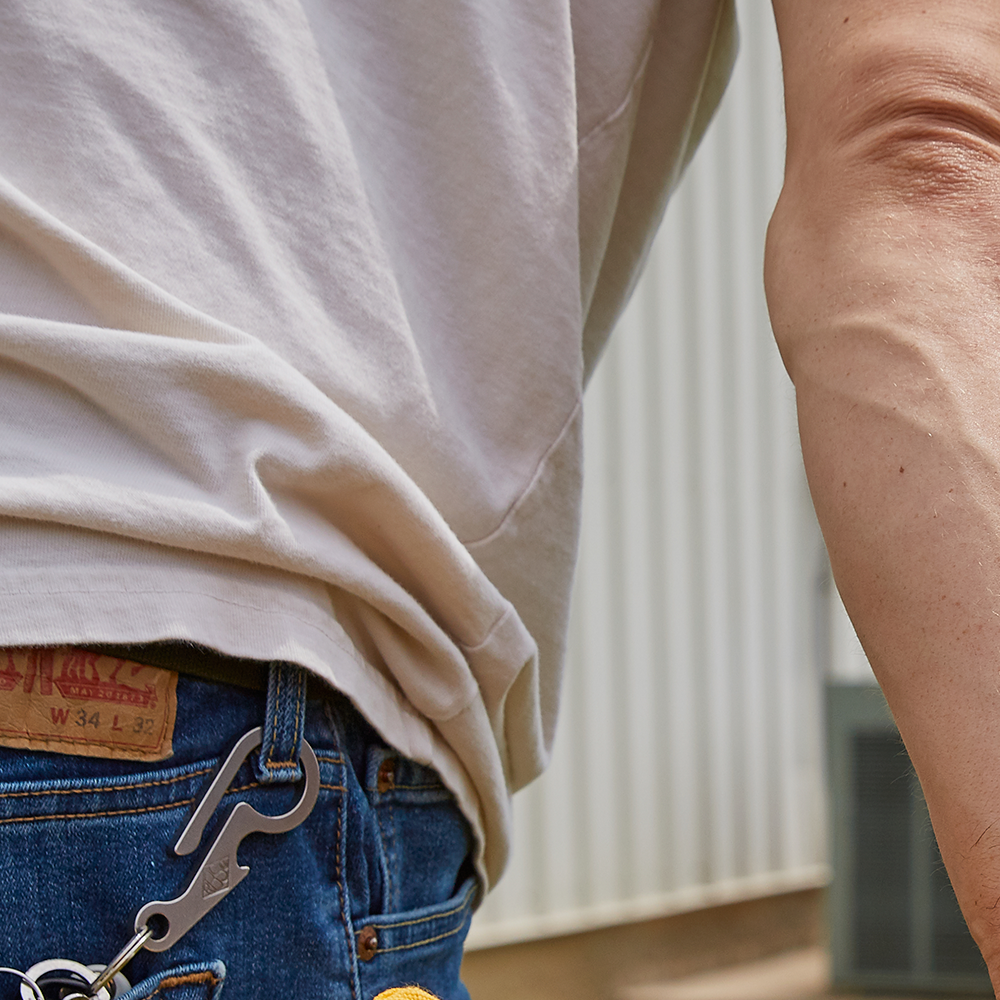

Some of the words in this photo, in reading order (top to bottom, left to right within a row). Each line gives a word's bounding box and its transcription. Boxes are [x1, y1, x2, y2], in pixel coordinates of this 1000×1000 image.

[50, 707, 70, 725] W
[75, 708, 101, 729] 34
[111, 715, 123, 732] L
[133, 716, 154, 735] 32
